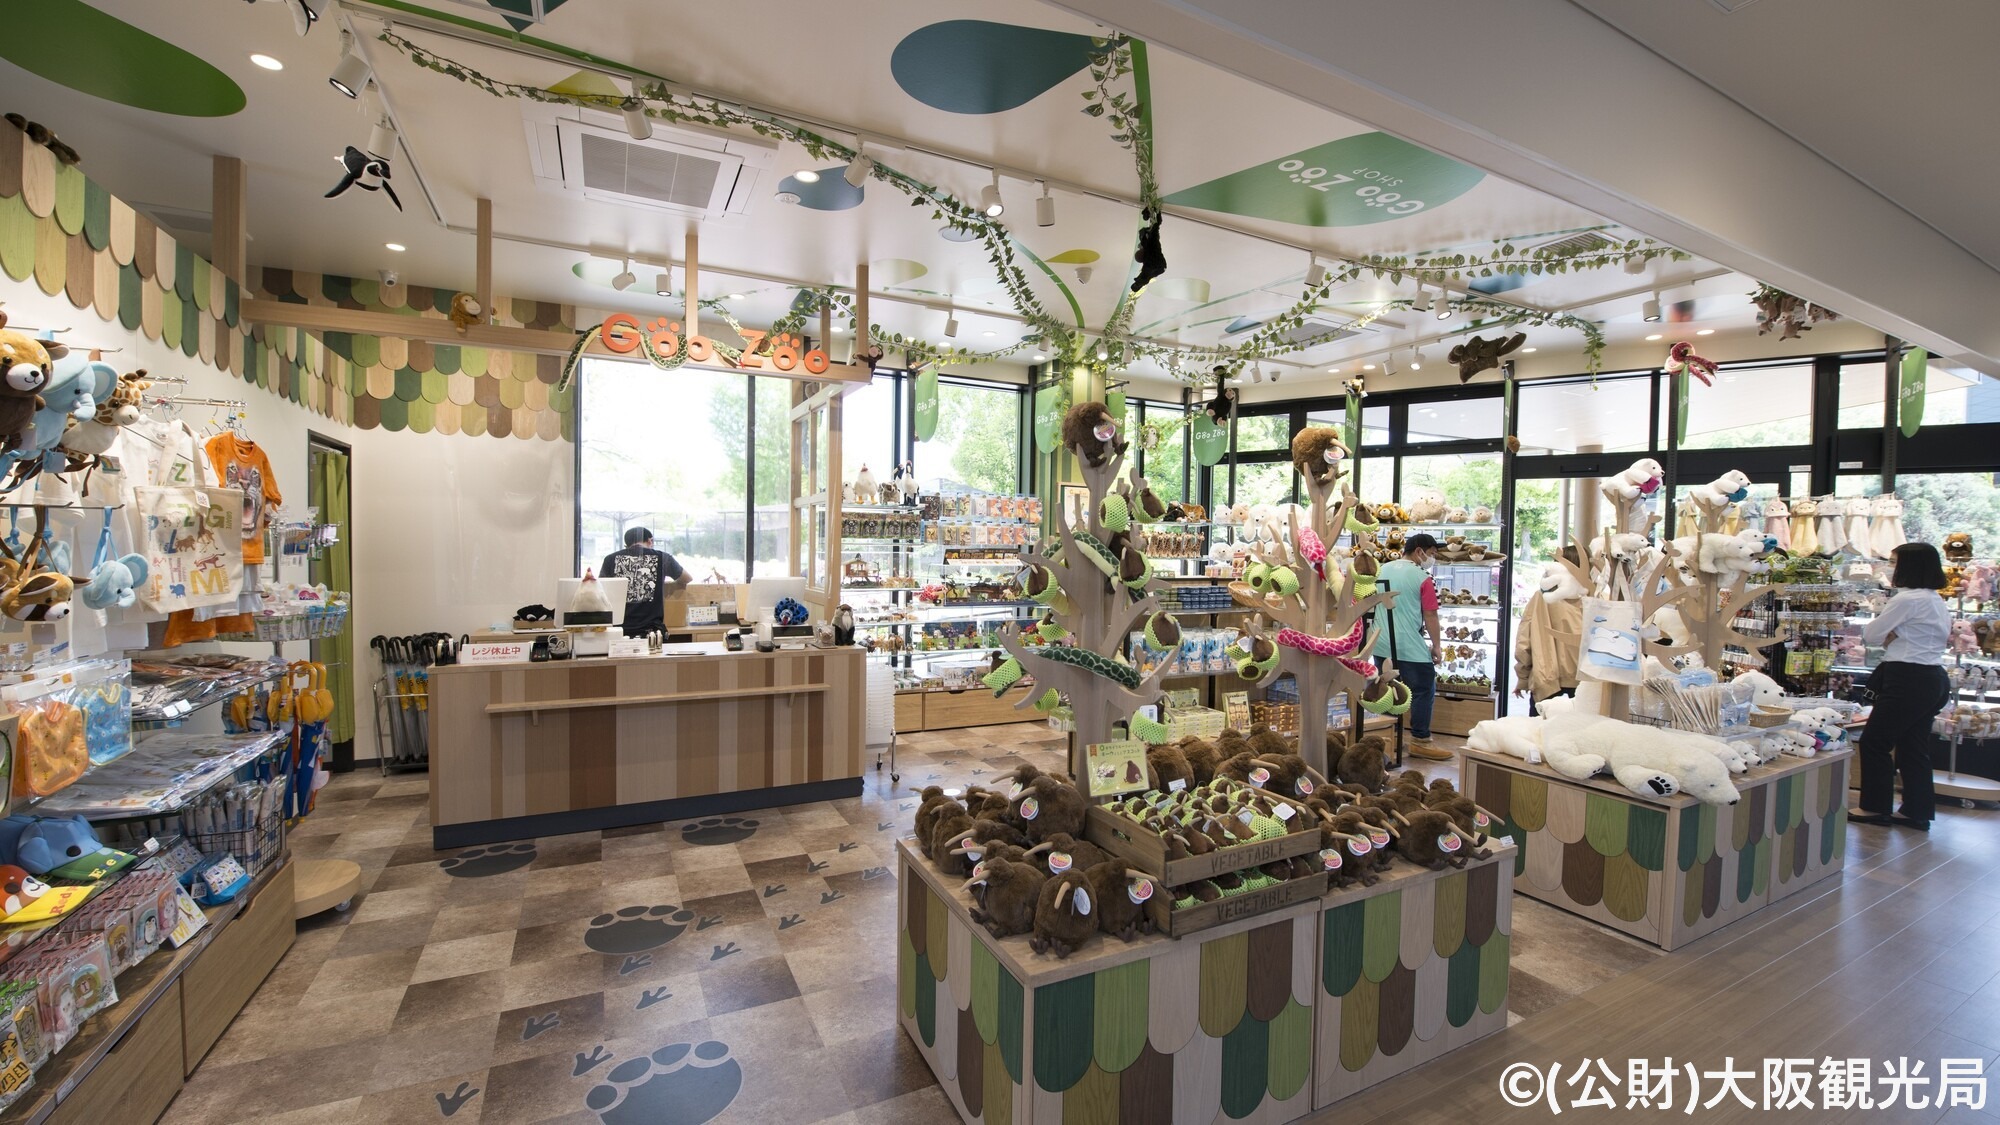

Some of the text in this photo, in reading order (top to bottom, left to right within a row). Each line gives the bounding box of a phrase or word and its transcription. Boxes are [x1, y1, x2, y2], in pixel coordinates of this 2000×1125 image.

[1352, 167, 1403, 187] SHOP
[472, 646, 521, 656] レジ休止中
[1211, 842, 1286, 873] VEGETABLE
[1216, 886, 1294, 920] VEGETABLE
